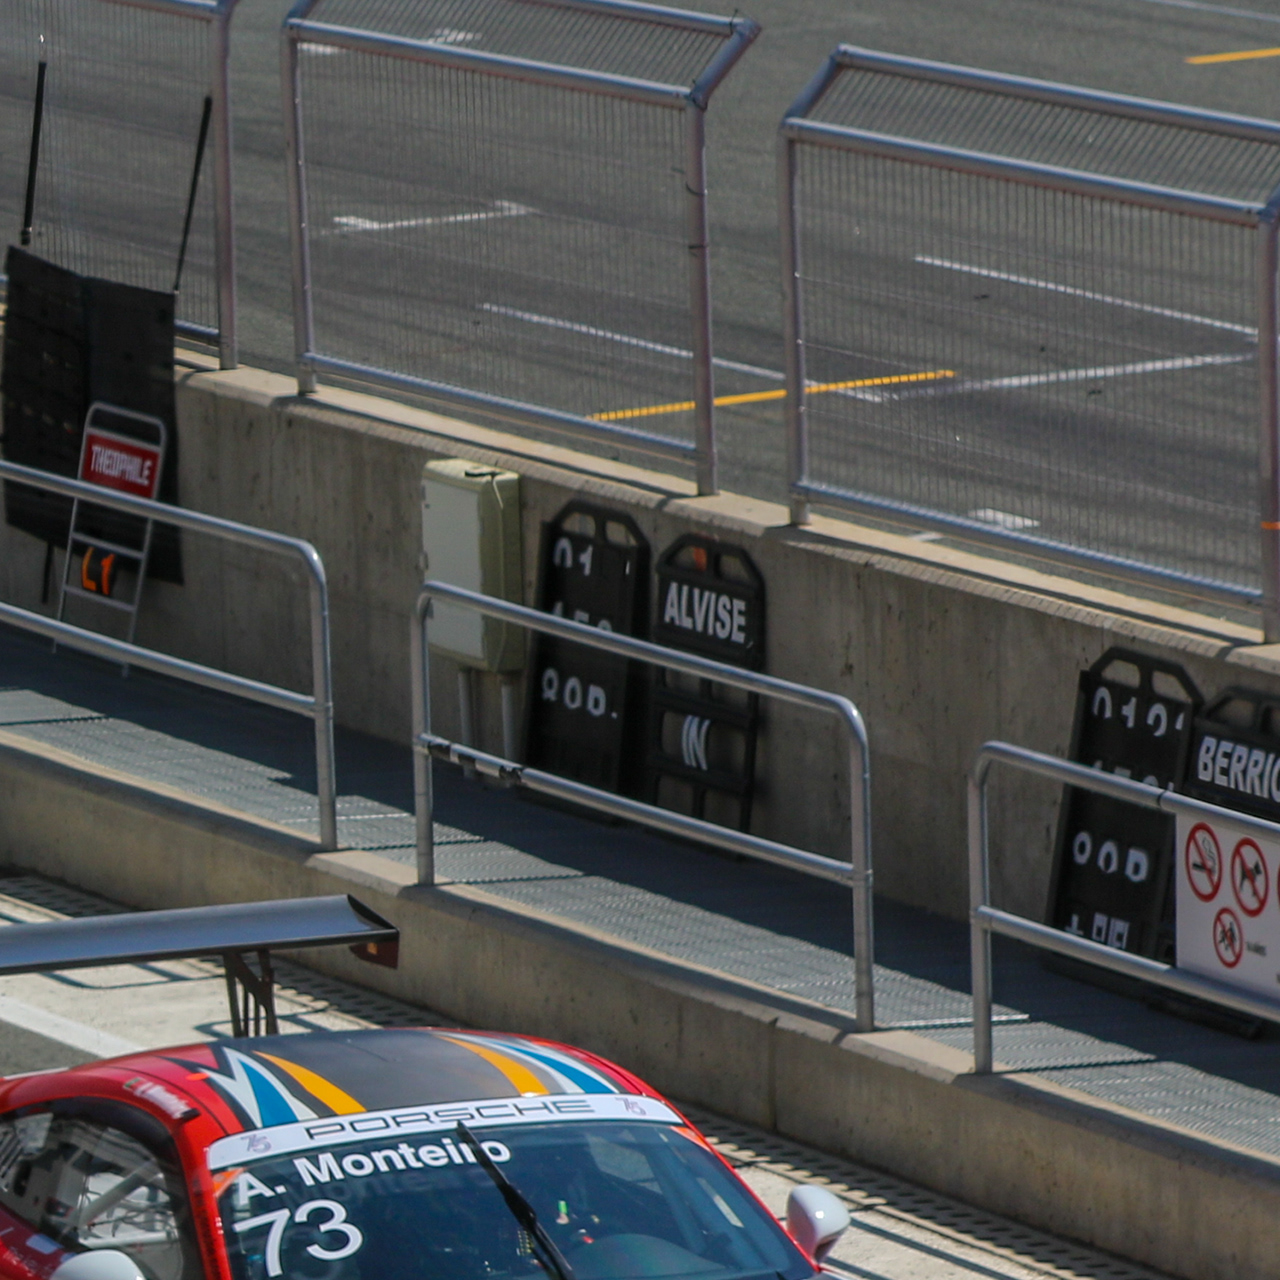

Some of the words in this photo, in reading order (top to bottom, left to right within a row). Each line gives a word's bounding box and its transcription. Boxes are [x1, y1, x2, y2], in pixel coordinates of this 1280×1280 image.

[90, 445, 152, 486] THEOPHILE
[664, 581, 747, 644] ALVISE
[304, 1098, 596, 1140] PORSCHE
[238, 1171, 288, 1206] A.
[232, 1199, 363, 1278] 73
